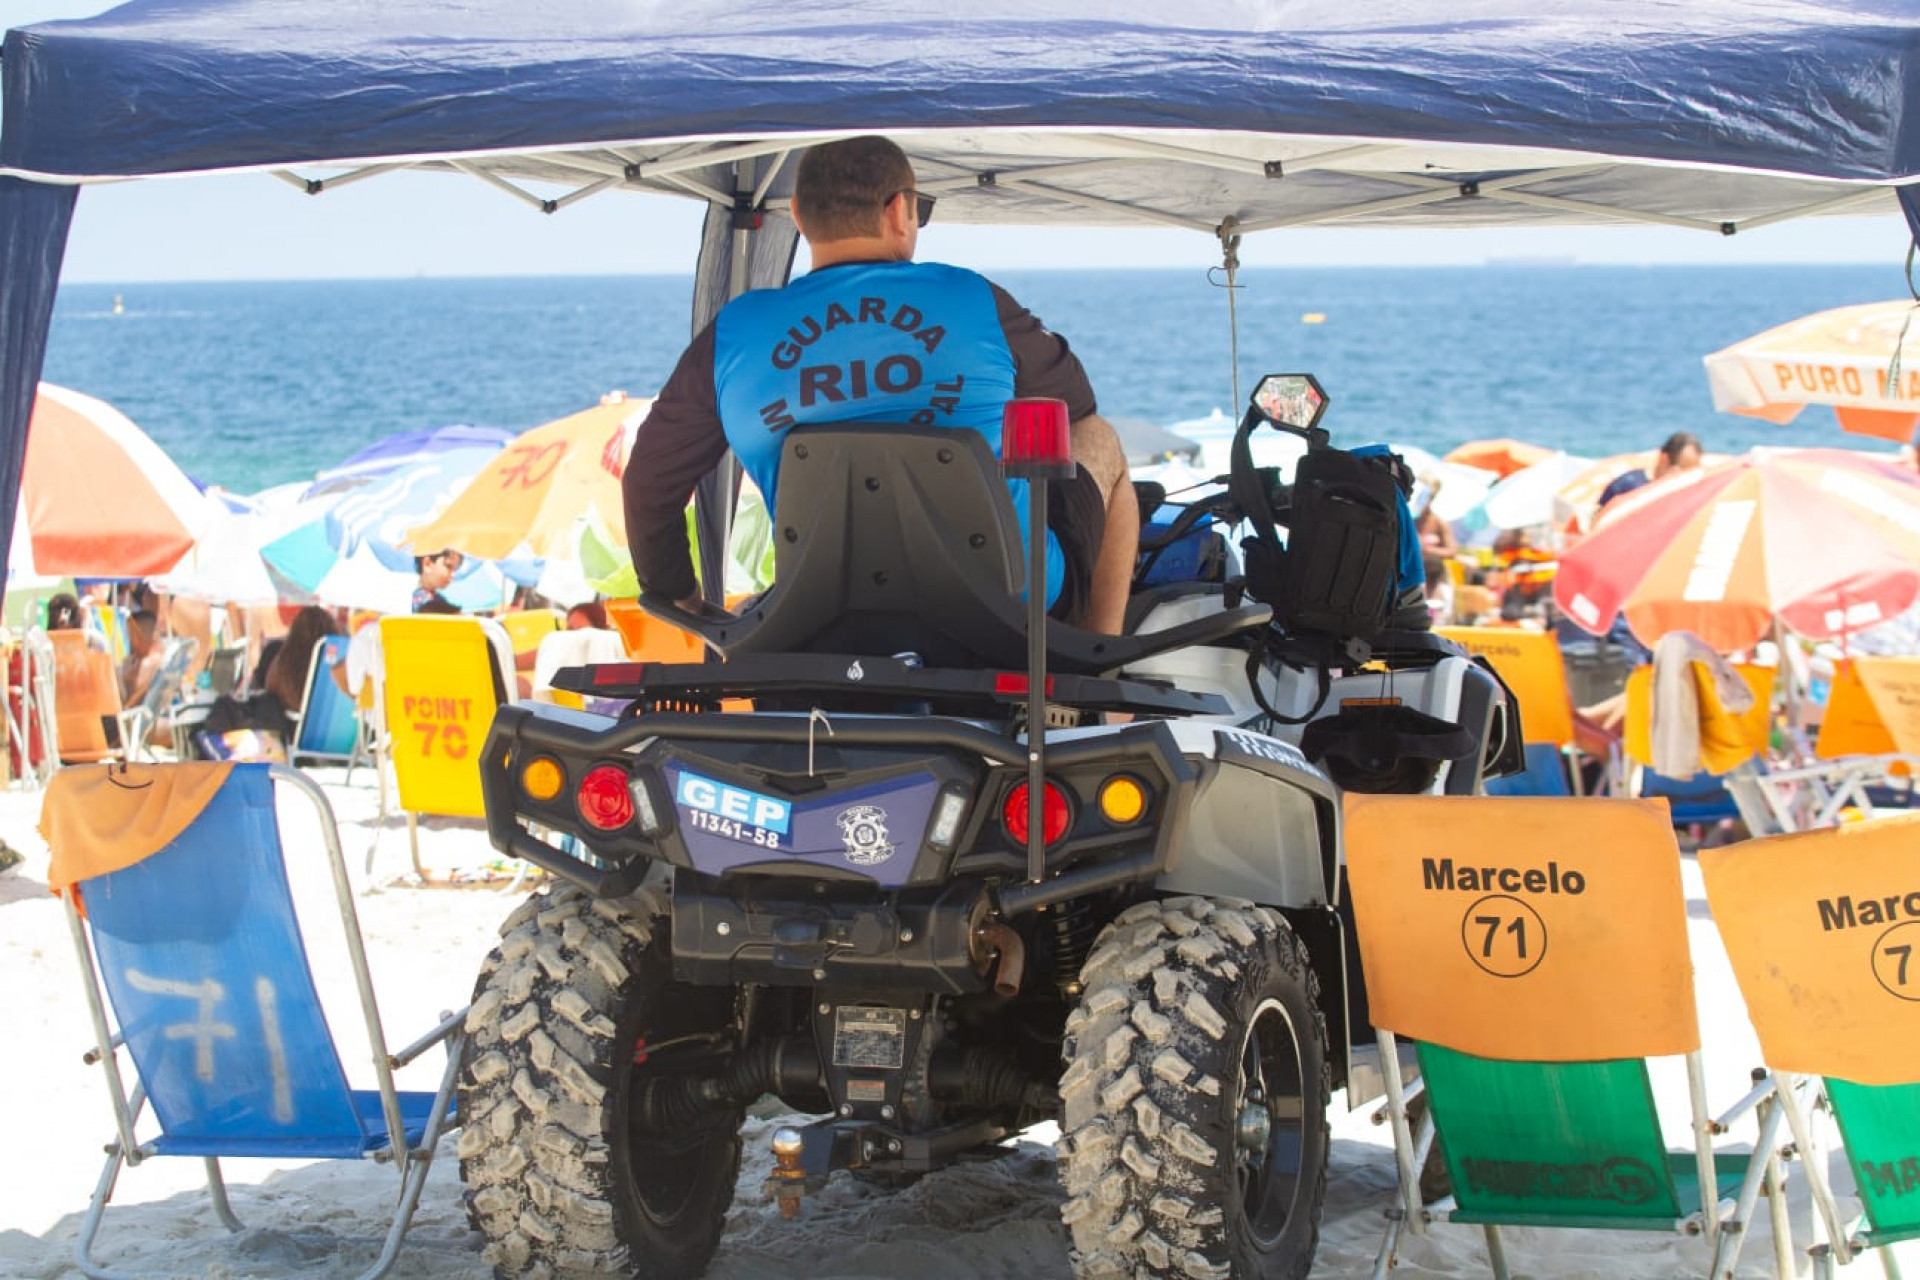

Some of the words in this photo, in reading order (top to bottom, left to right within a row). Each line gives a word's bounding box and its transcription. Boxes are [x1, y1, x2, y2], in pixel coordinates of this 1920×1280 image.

[771, 296, 946, 370] GUARDA
[801, 354, 923, 407] RIO
[1774, 363, 1863, 396] PURO
[403, 695, 472, 720] POINT
[413, 723, 469, 761] 70
[684, 780, 784, 824] GEP
[690, 810, 780, 849] 11341-58
[1422, 858, 1586, 895] Marcelo
[1817, 891, 1920, 931] Marc
[1475, 916, 1527, 959] 71
[1883, 945, 1912, 985] 7
[125, 969, 297, 1123] 71
